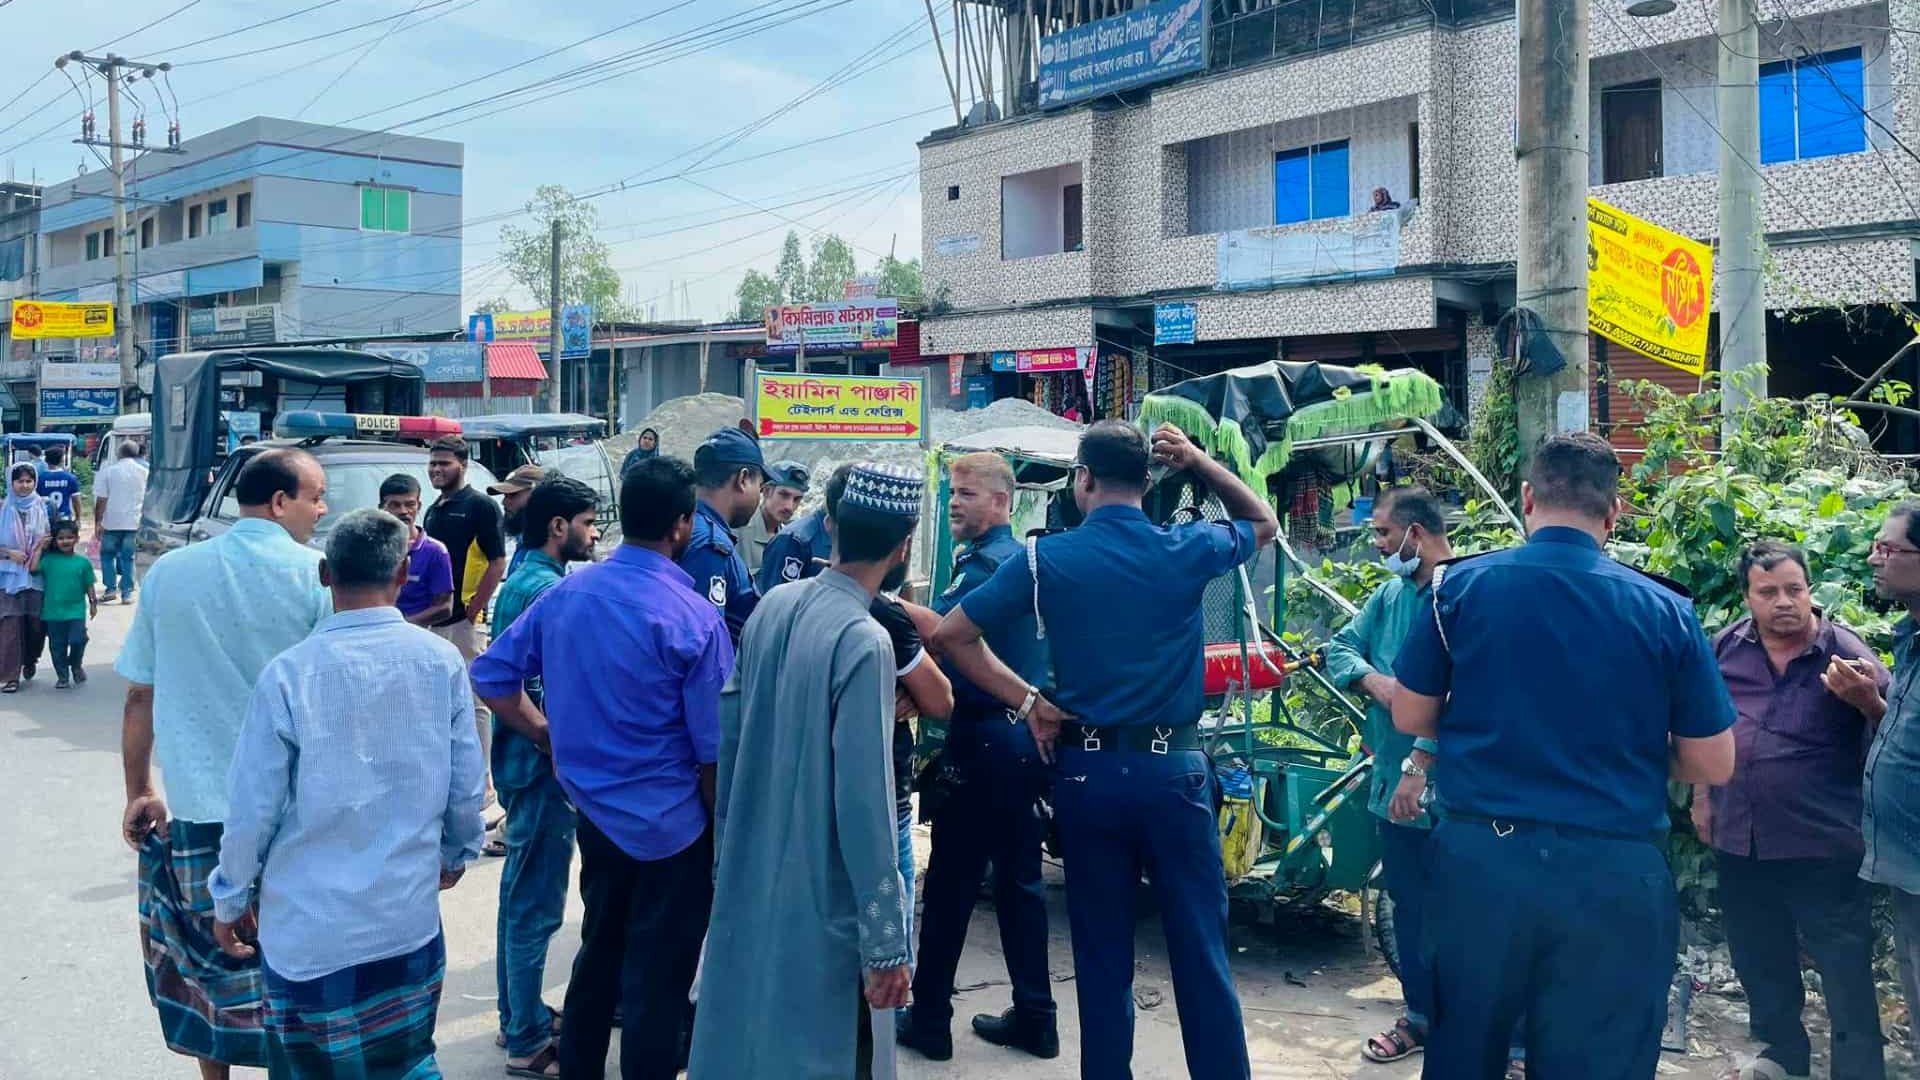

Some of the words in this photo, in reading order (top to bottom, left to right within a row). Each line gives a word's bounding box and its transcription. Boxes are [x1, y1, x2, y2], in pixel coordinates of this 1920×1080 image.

[1070, 29, 1097, 58] Internet
[1098, 22, 1125, 50] Service
[1126, 12, 1158, 42] Provider
[782, 306, 835, 326] বিসমিল্লাহ
[839, 305, 874, 323] মটরস
[763, 378, 841, 400] ইয়ামিন
[850, 381, 918, 401] পাঞ্জাবী
[787, 404, 835, 417] টেইলার্স
[864, 405, 904, 418] ফেব্রিক্স
[360, 416, 397, 429] POLICE
